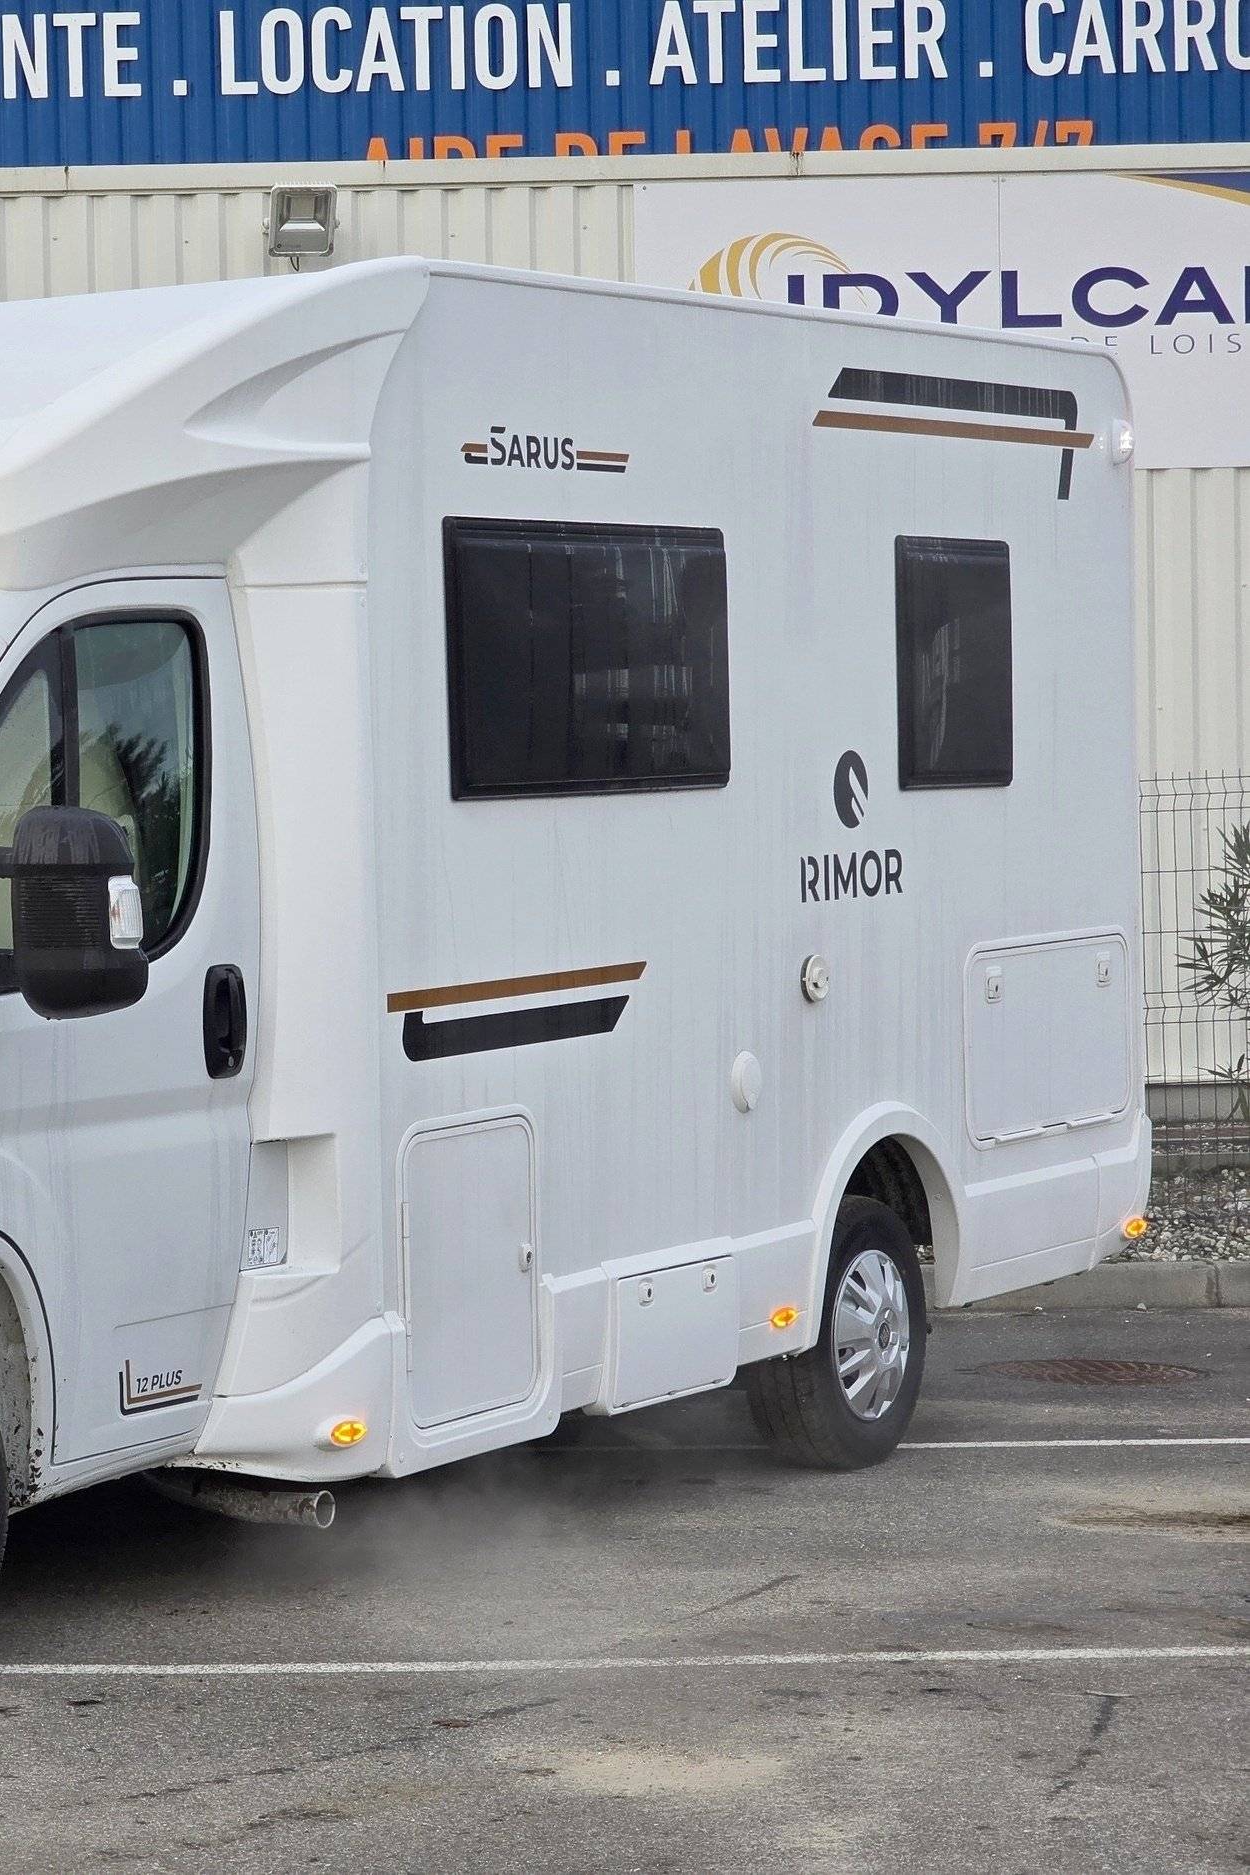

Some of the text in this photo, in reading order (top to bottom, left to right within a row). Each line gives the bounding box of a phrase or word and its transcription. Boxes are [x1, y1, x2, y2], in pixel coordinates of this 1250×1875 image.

[220, 3, 573, 95] LOCATION
[649, 0, 948, 85] ATELIER
[787, 266, 1250, 329] IDYLCA
[1150, 333, 1242, 355] LOIS
[490, 425, 576, 471] SARUS
[800, 848, 904, 903] RIMOR
[136, 1369, 183, 1394] 12 PLUS
